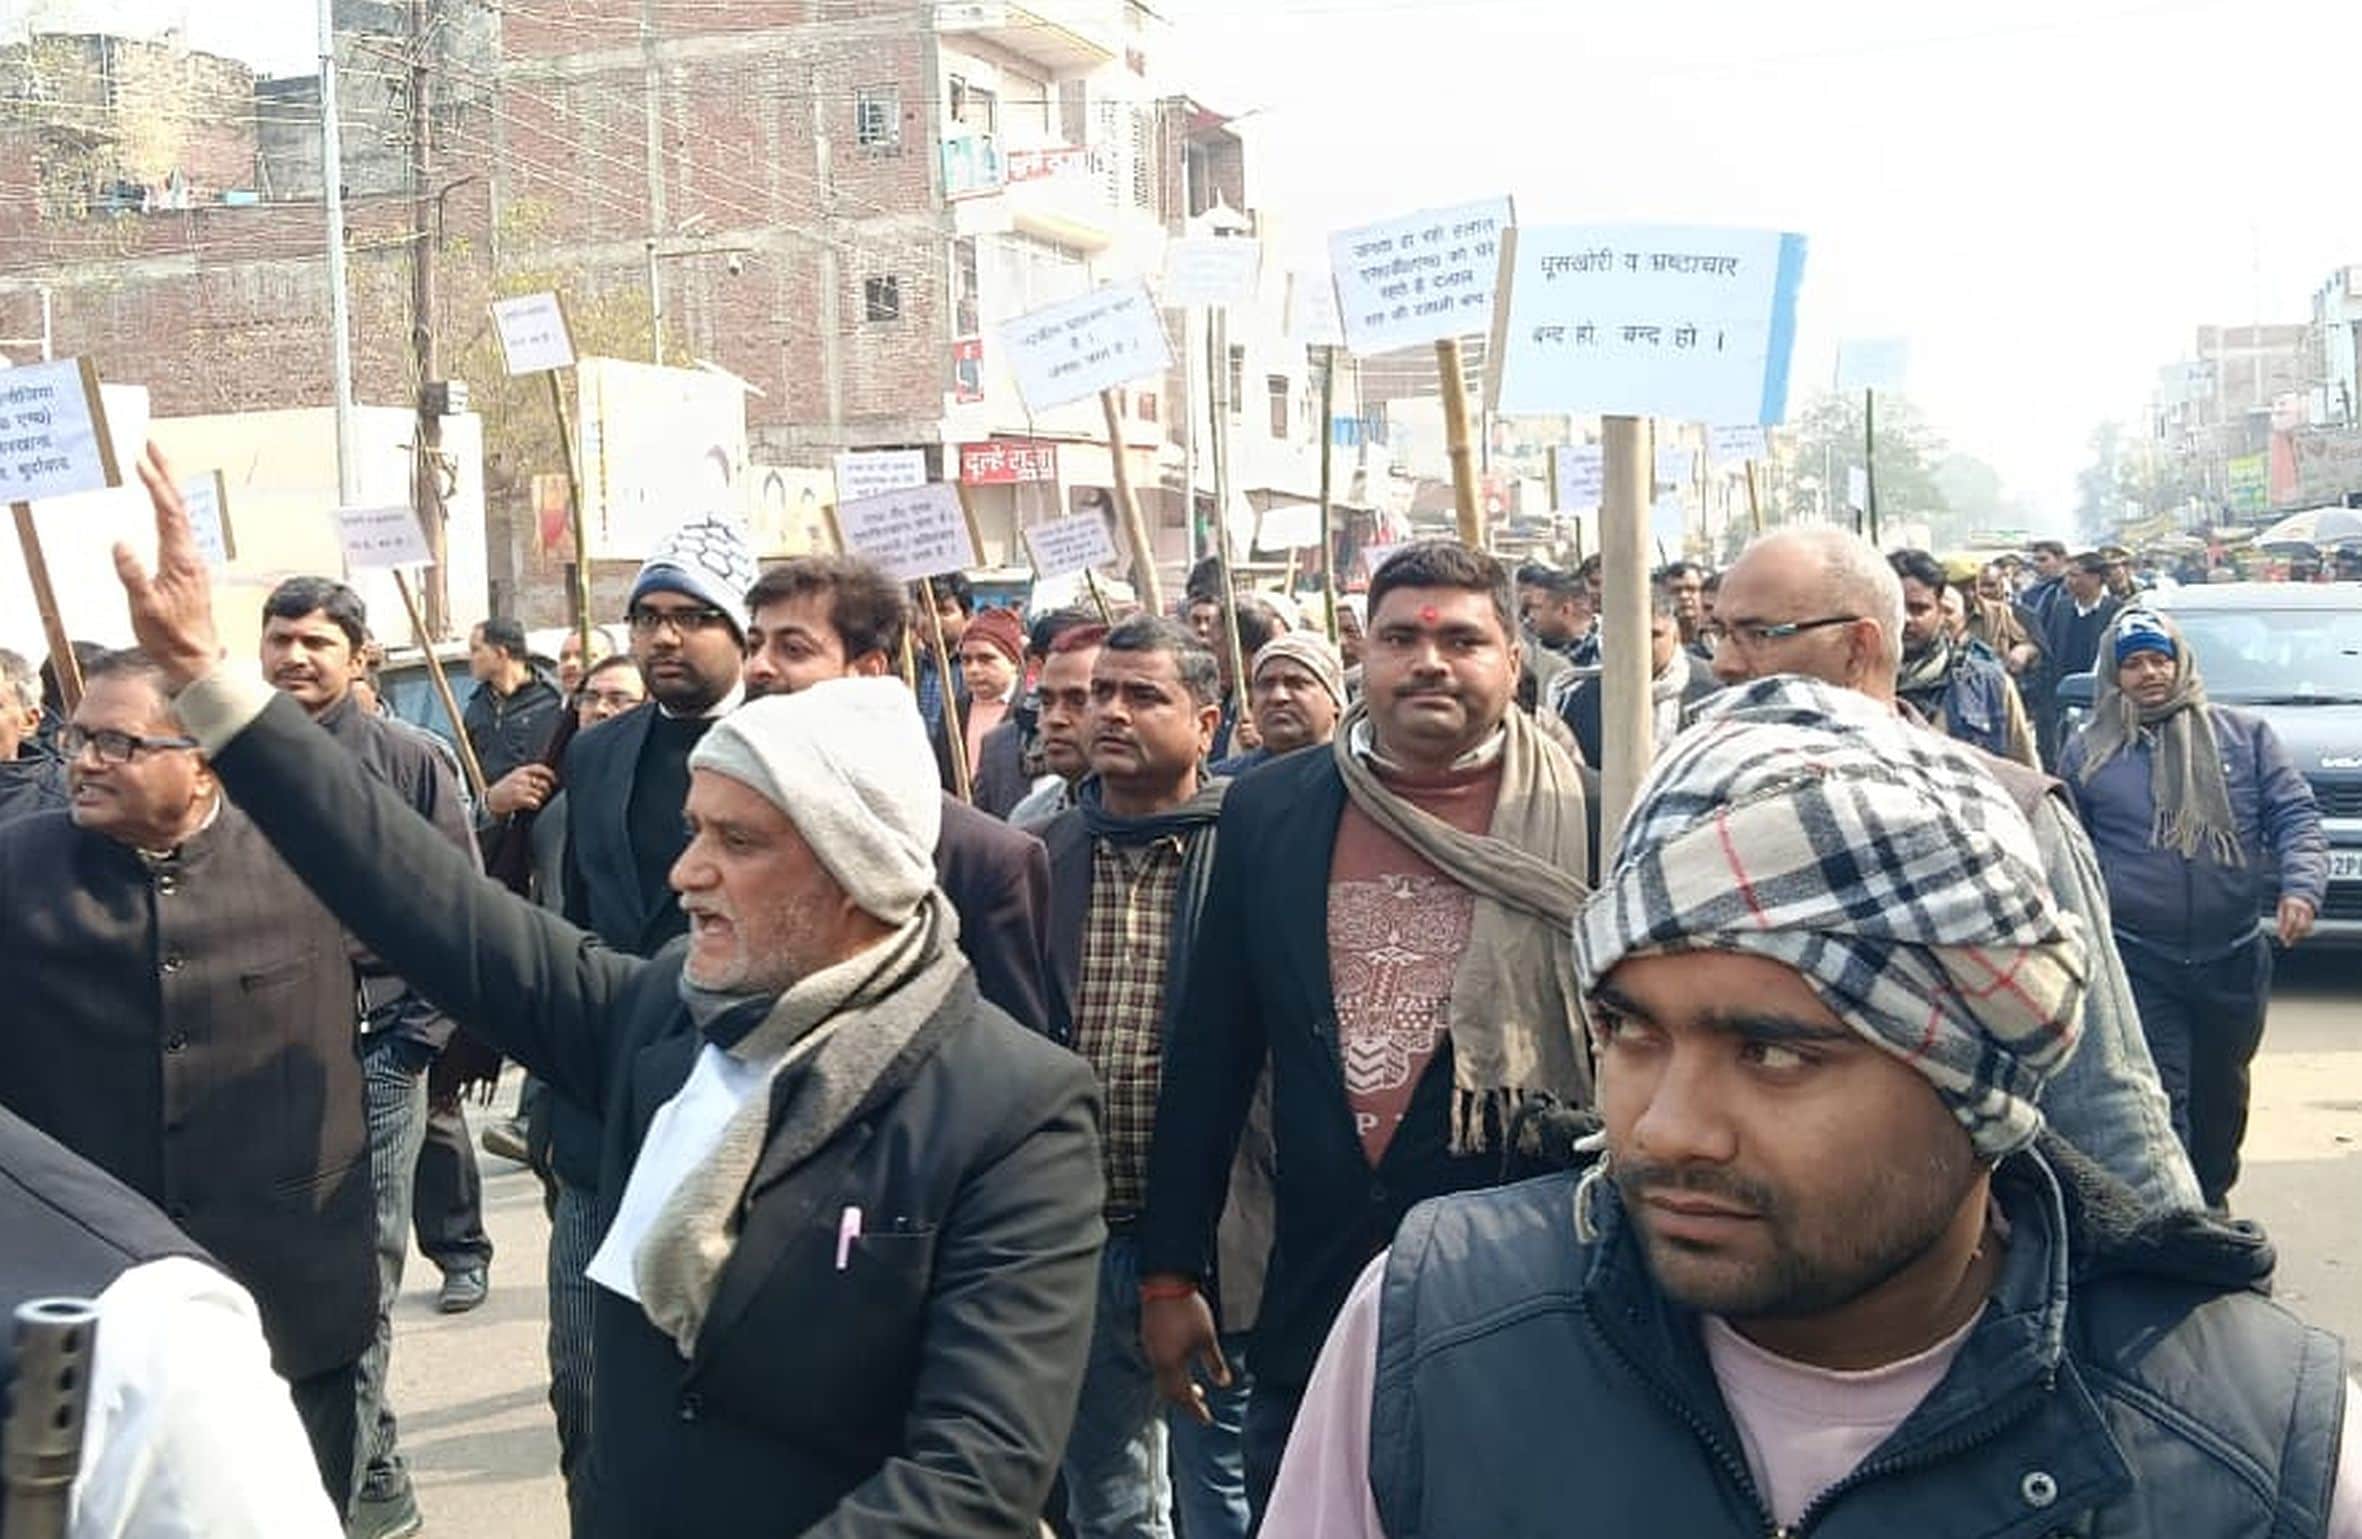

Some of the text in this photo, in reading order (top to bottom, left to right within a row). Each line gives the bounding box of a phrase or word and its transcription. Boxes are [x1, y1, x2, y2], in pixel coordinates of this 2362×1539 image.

[1649, 252, 1740, 277] भ्रष्टाचार
[1532, 325, 1566, 344] बन्द
[1617, 325, 1662, 346] बन्द
[1674, 322, 1698, 349] हो
